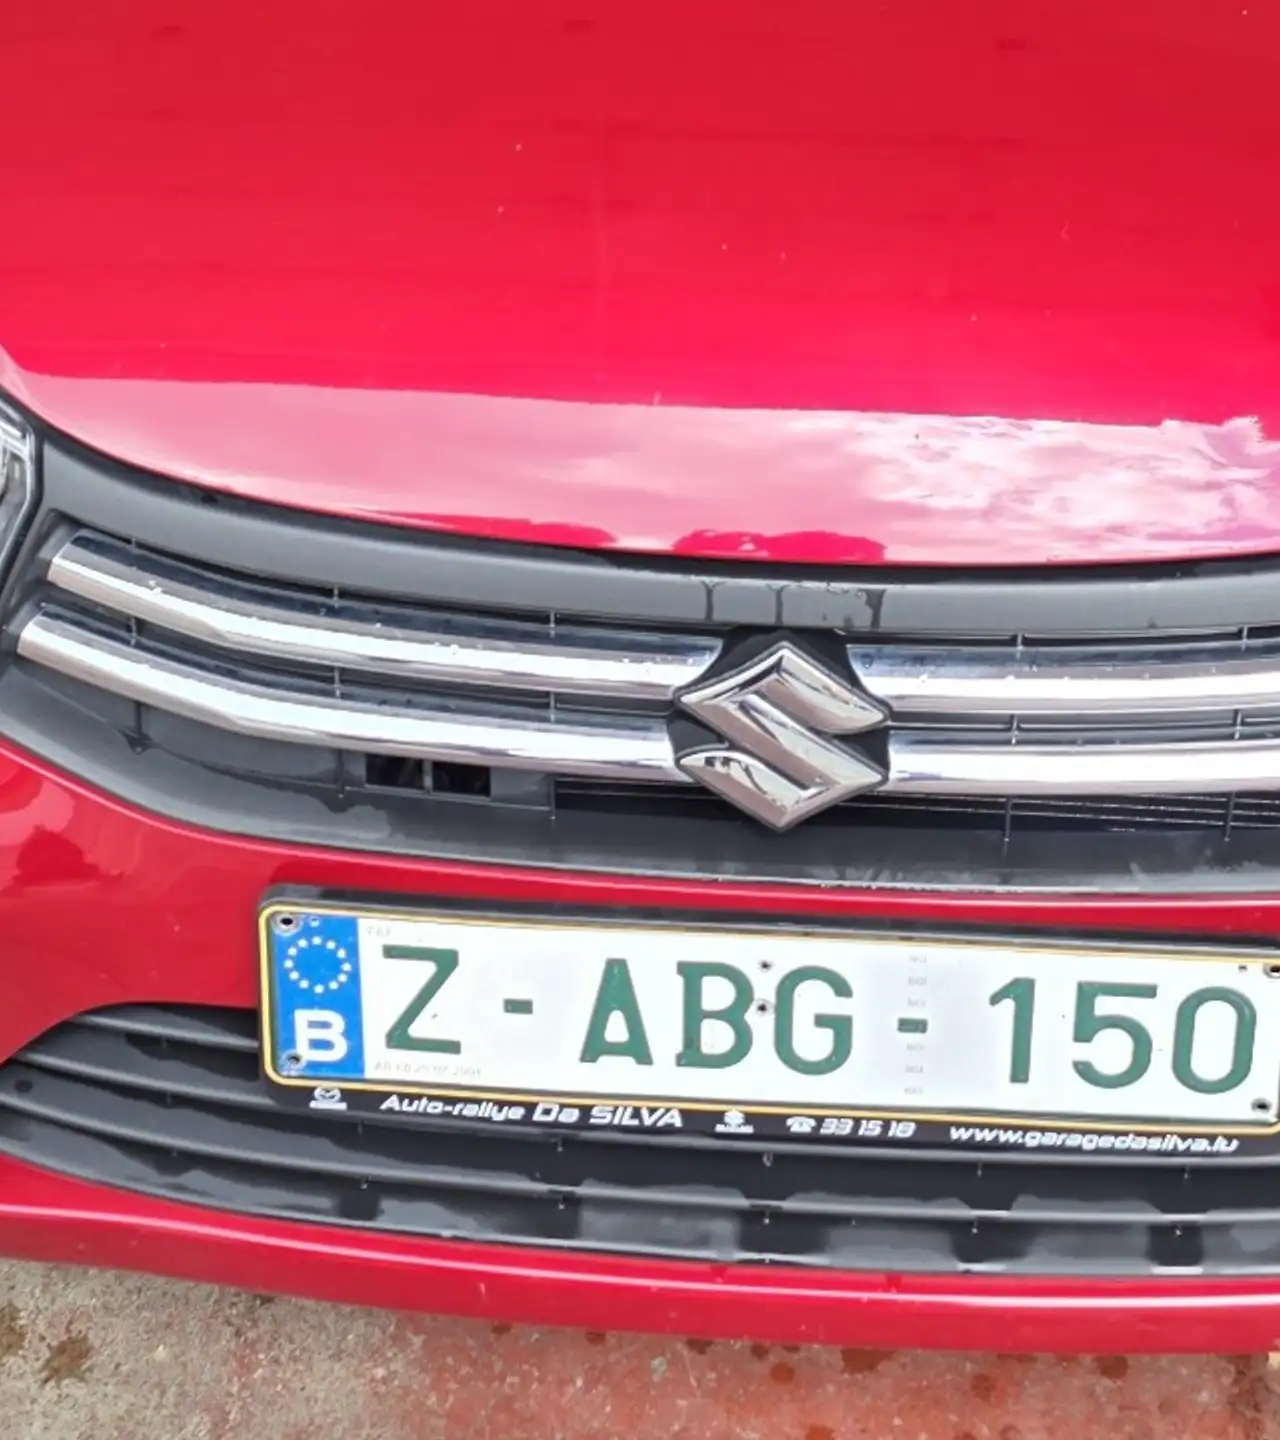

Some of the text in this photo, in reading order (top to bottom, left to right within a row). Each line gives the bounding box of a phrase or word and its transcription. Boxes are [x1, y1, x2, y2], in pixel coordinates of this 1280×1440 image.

[294, 1009, 348, 1062] B
[380, 1094, 683, 1127] Auto-rallye Da SILVA
[820, 1118, 854, 1135] 33
[858, 1120, 883, 1136] 15
[949, 1126, 1239, 1152] www.garagedasilva.lu
